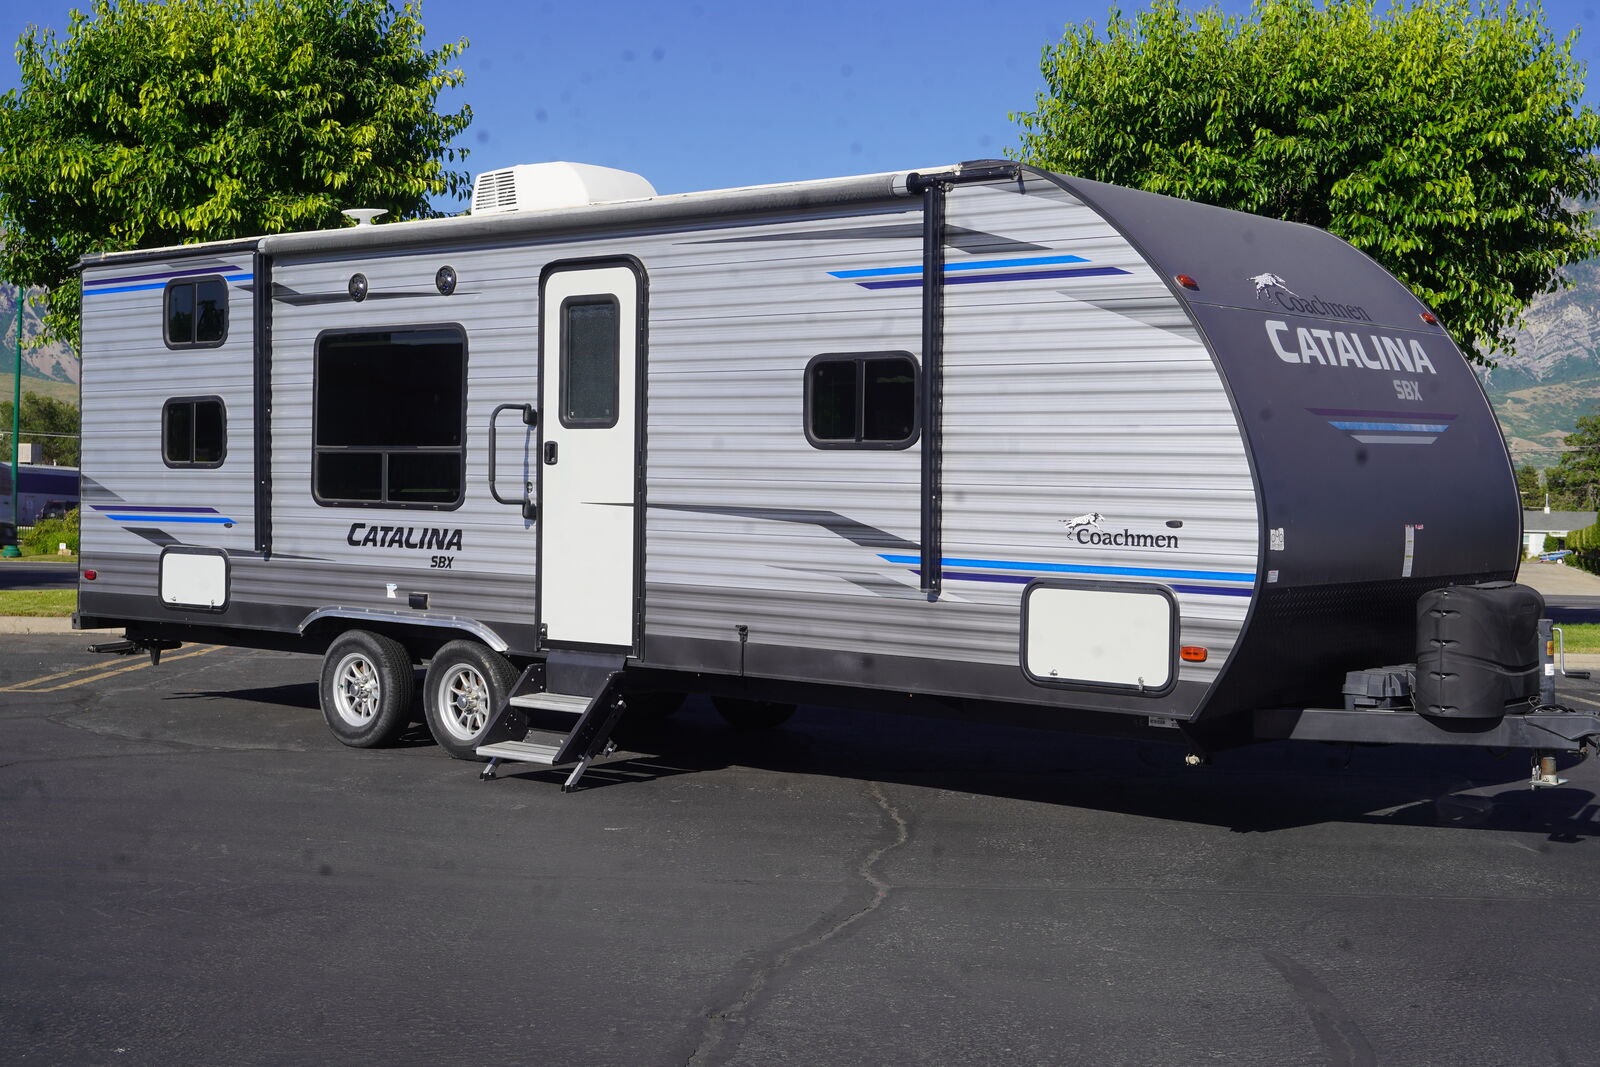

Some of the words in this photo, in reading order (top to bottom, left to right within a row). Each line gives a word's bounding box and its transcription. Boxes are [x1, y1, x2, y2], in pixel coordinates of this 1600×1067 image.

[1275, 291, 1373, 322] Coachmen
[1265, 319, 1437, 375] CATALINA
[1393, 379, 1423, 402] SBX
[347, 522, 463, 551] CATALINA
[1076, 528, 1179, 549] Coachmen
[430, 555, 455, 569] SBX
